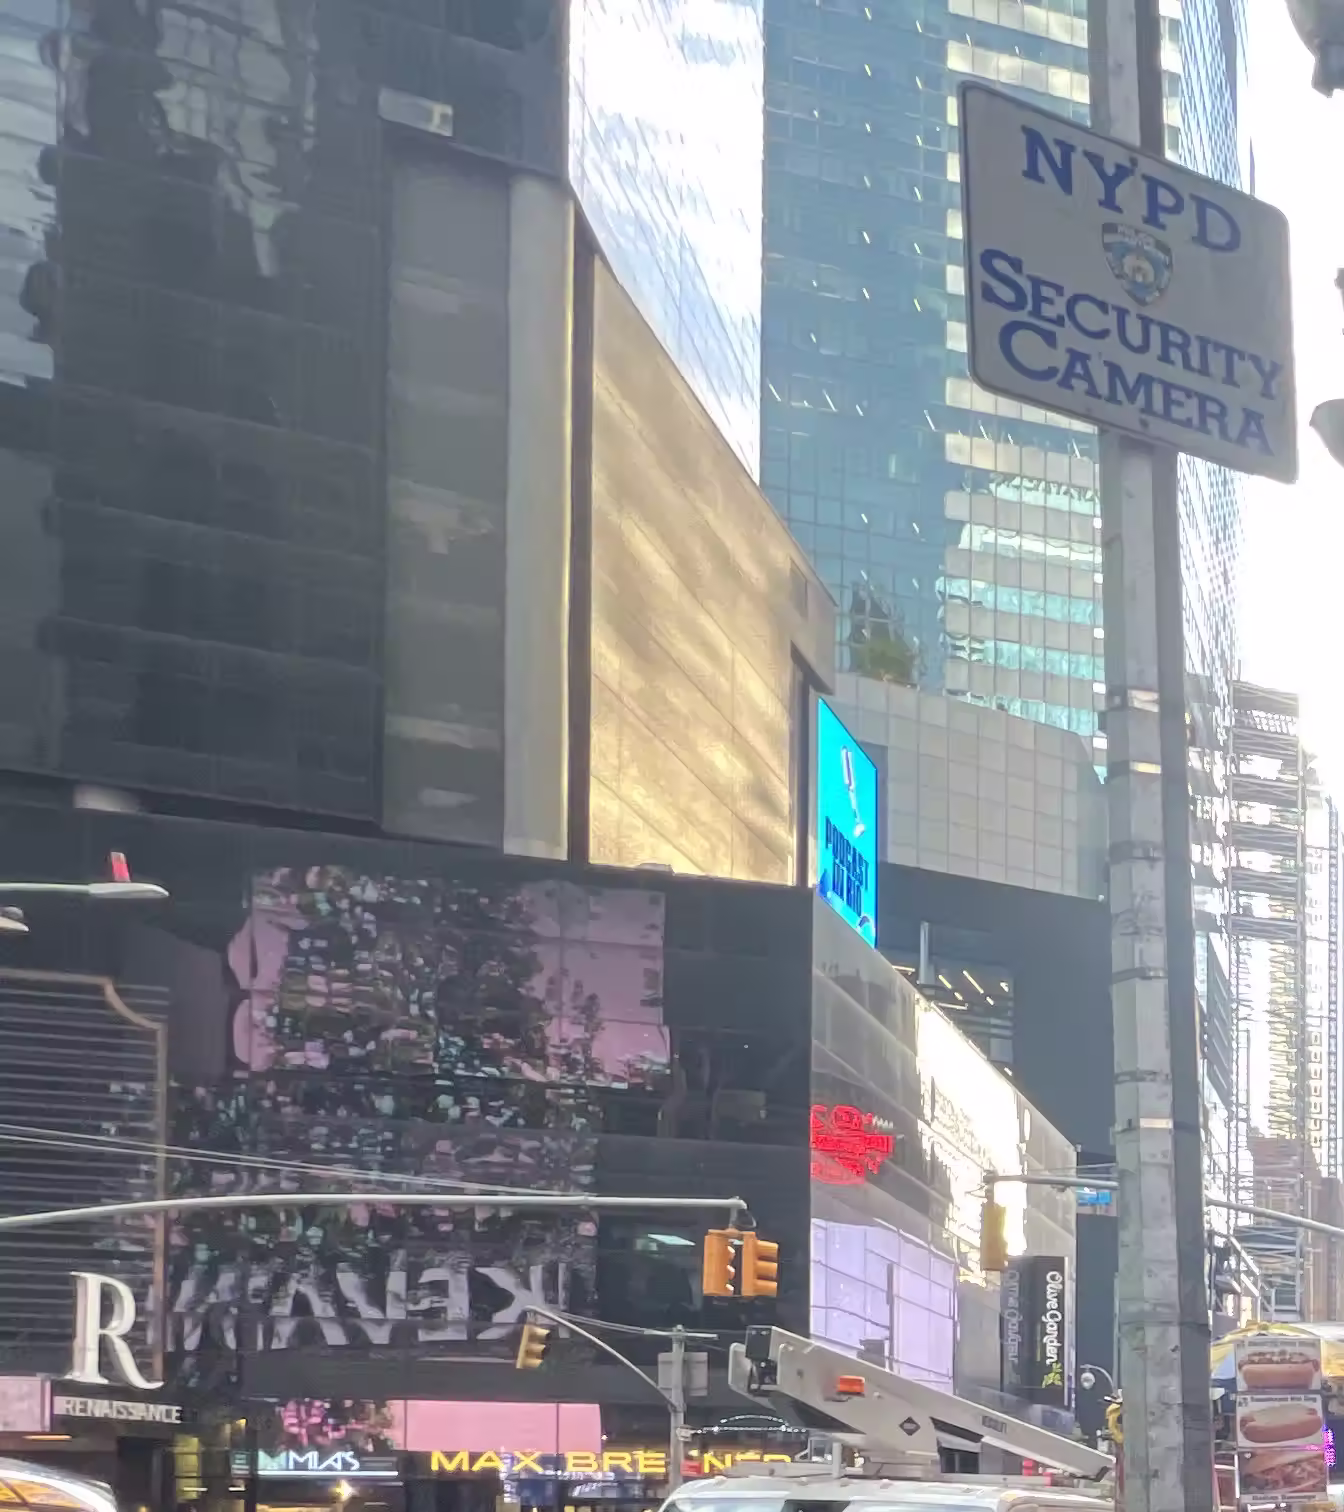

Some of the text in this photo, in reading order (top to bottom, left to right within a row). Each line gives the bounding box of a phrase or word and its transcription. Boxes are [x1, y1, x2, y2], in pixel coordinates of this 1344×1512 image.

[1020, 124, 1242, 252] NYPD
[978, 248, 1286, 400] SECURITY
[998, 320, 1276, 457] CAMERA
[62, 1271, 165, 1390] R
[1042, 1270, 1062, 1366] Olive Garden
[63, 1398, 183, 1424] RENAISSANCE
[430, 1450, 544, 1473] MAX
